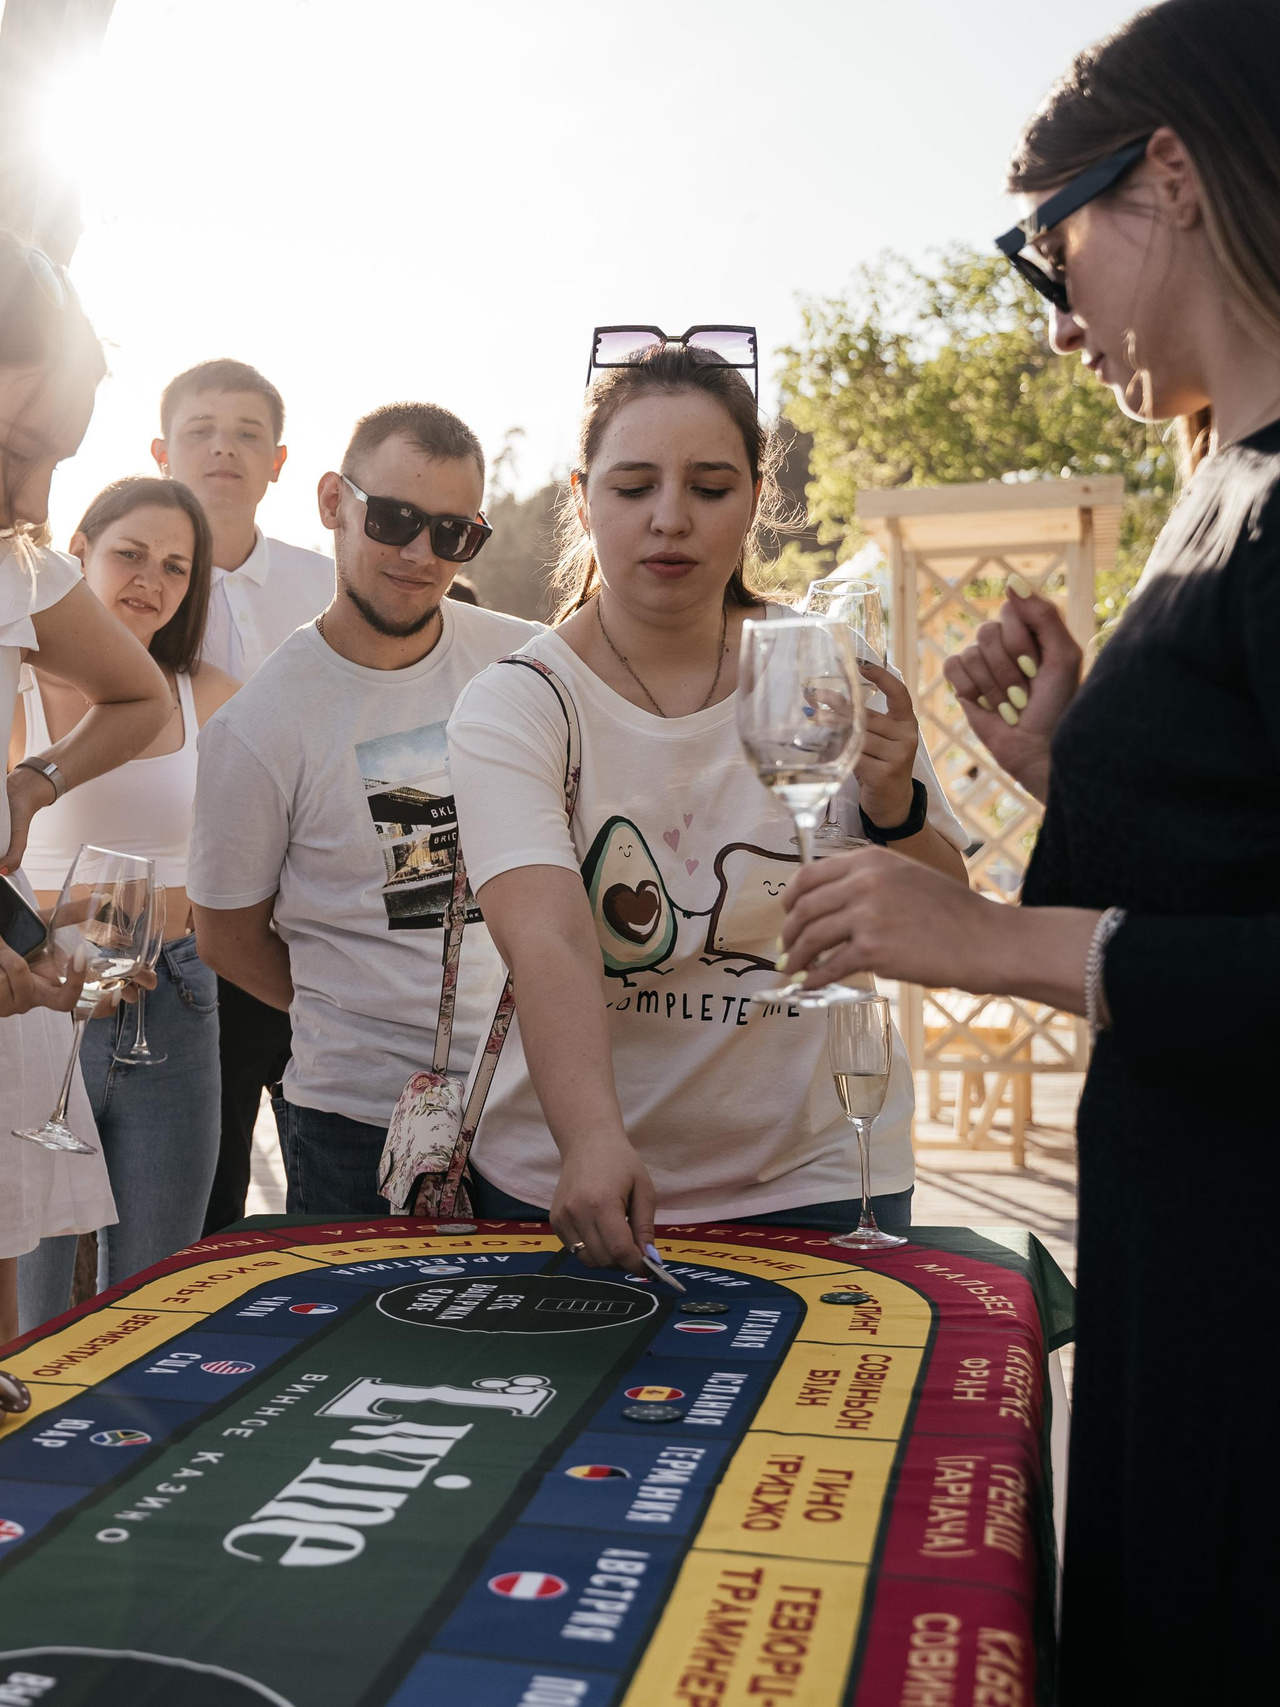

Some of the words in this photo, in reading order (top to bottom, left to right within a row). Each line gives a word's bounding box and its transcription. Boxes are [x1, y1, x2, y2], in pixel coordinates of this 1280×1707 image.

[430, 805, 455, 819] BKL
[606, 990, 752, 1026] OMPLETE
[321, 1222, 542, 1237] БАБЕРА
[322, 1240, 542, 1257] КОРТЕЗЕ
[665, 1226, 830, 1246] МЕРЛО
[330, 1255, 510, 1276] АРГЕНТИНА
[656, 1246, 806, 1273] АРДОНЕ
[661, 1264, 751, 1287] НЦИЯ
[161, 1260, 282, 1304] ВИОНЬЕ
[913, 1262, 1018, 1318] МАЛЬБЕК
[235, 1295, 292, 1318] ЧИЛИ
[831, 1284, 882, 1336] РЛИНГ
[32, 1313, 160, 1377] ВЕРМЕНТИНО
[730, 1309, 781, 1349] ИТАЛИЯ
[145, 1352, 202, 1374] США
[952, 1357, 992, 1401] ФРАН
[223, 1373, 329, 1439] ВИННОЕ
[683, 1371, 749, 1426] ИСПАНИЯ
[795, 1368, 841, 1407] БЛАН
[834, 1353, 893, 1431] СОВИНЬОН
[32, 1417, 95, 1449] ЮАР
[96, 1450, 225, 1543] КАЗИНО
[625, 1446, 707, 1524] ГЕРМНИЯ
[901, 1612, 962, 1707] СОВИН
[972, 1626, 1024, 1707] КАБЕ
